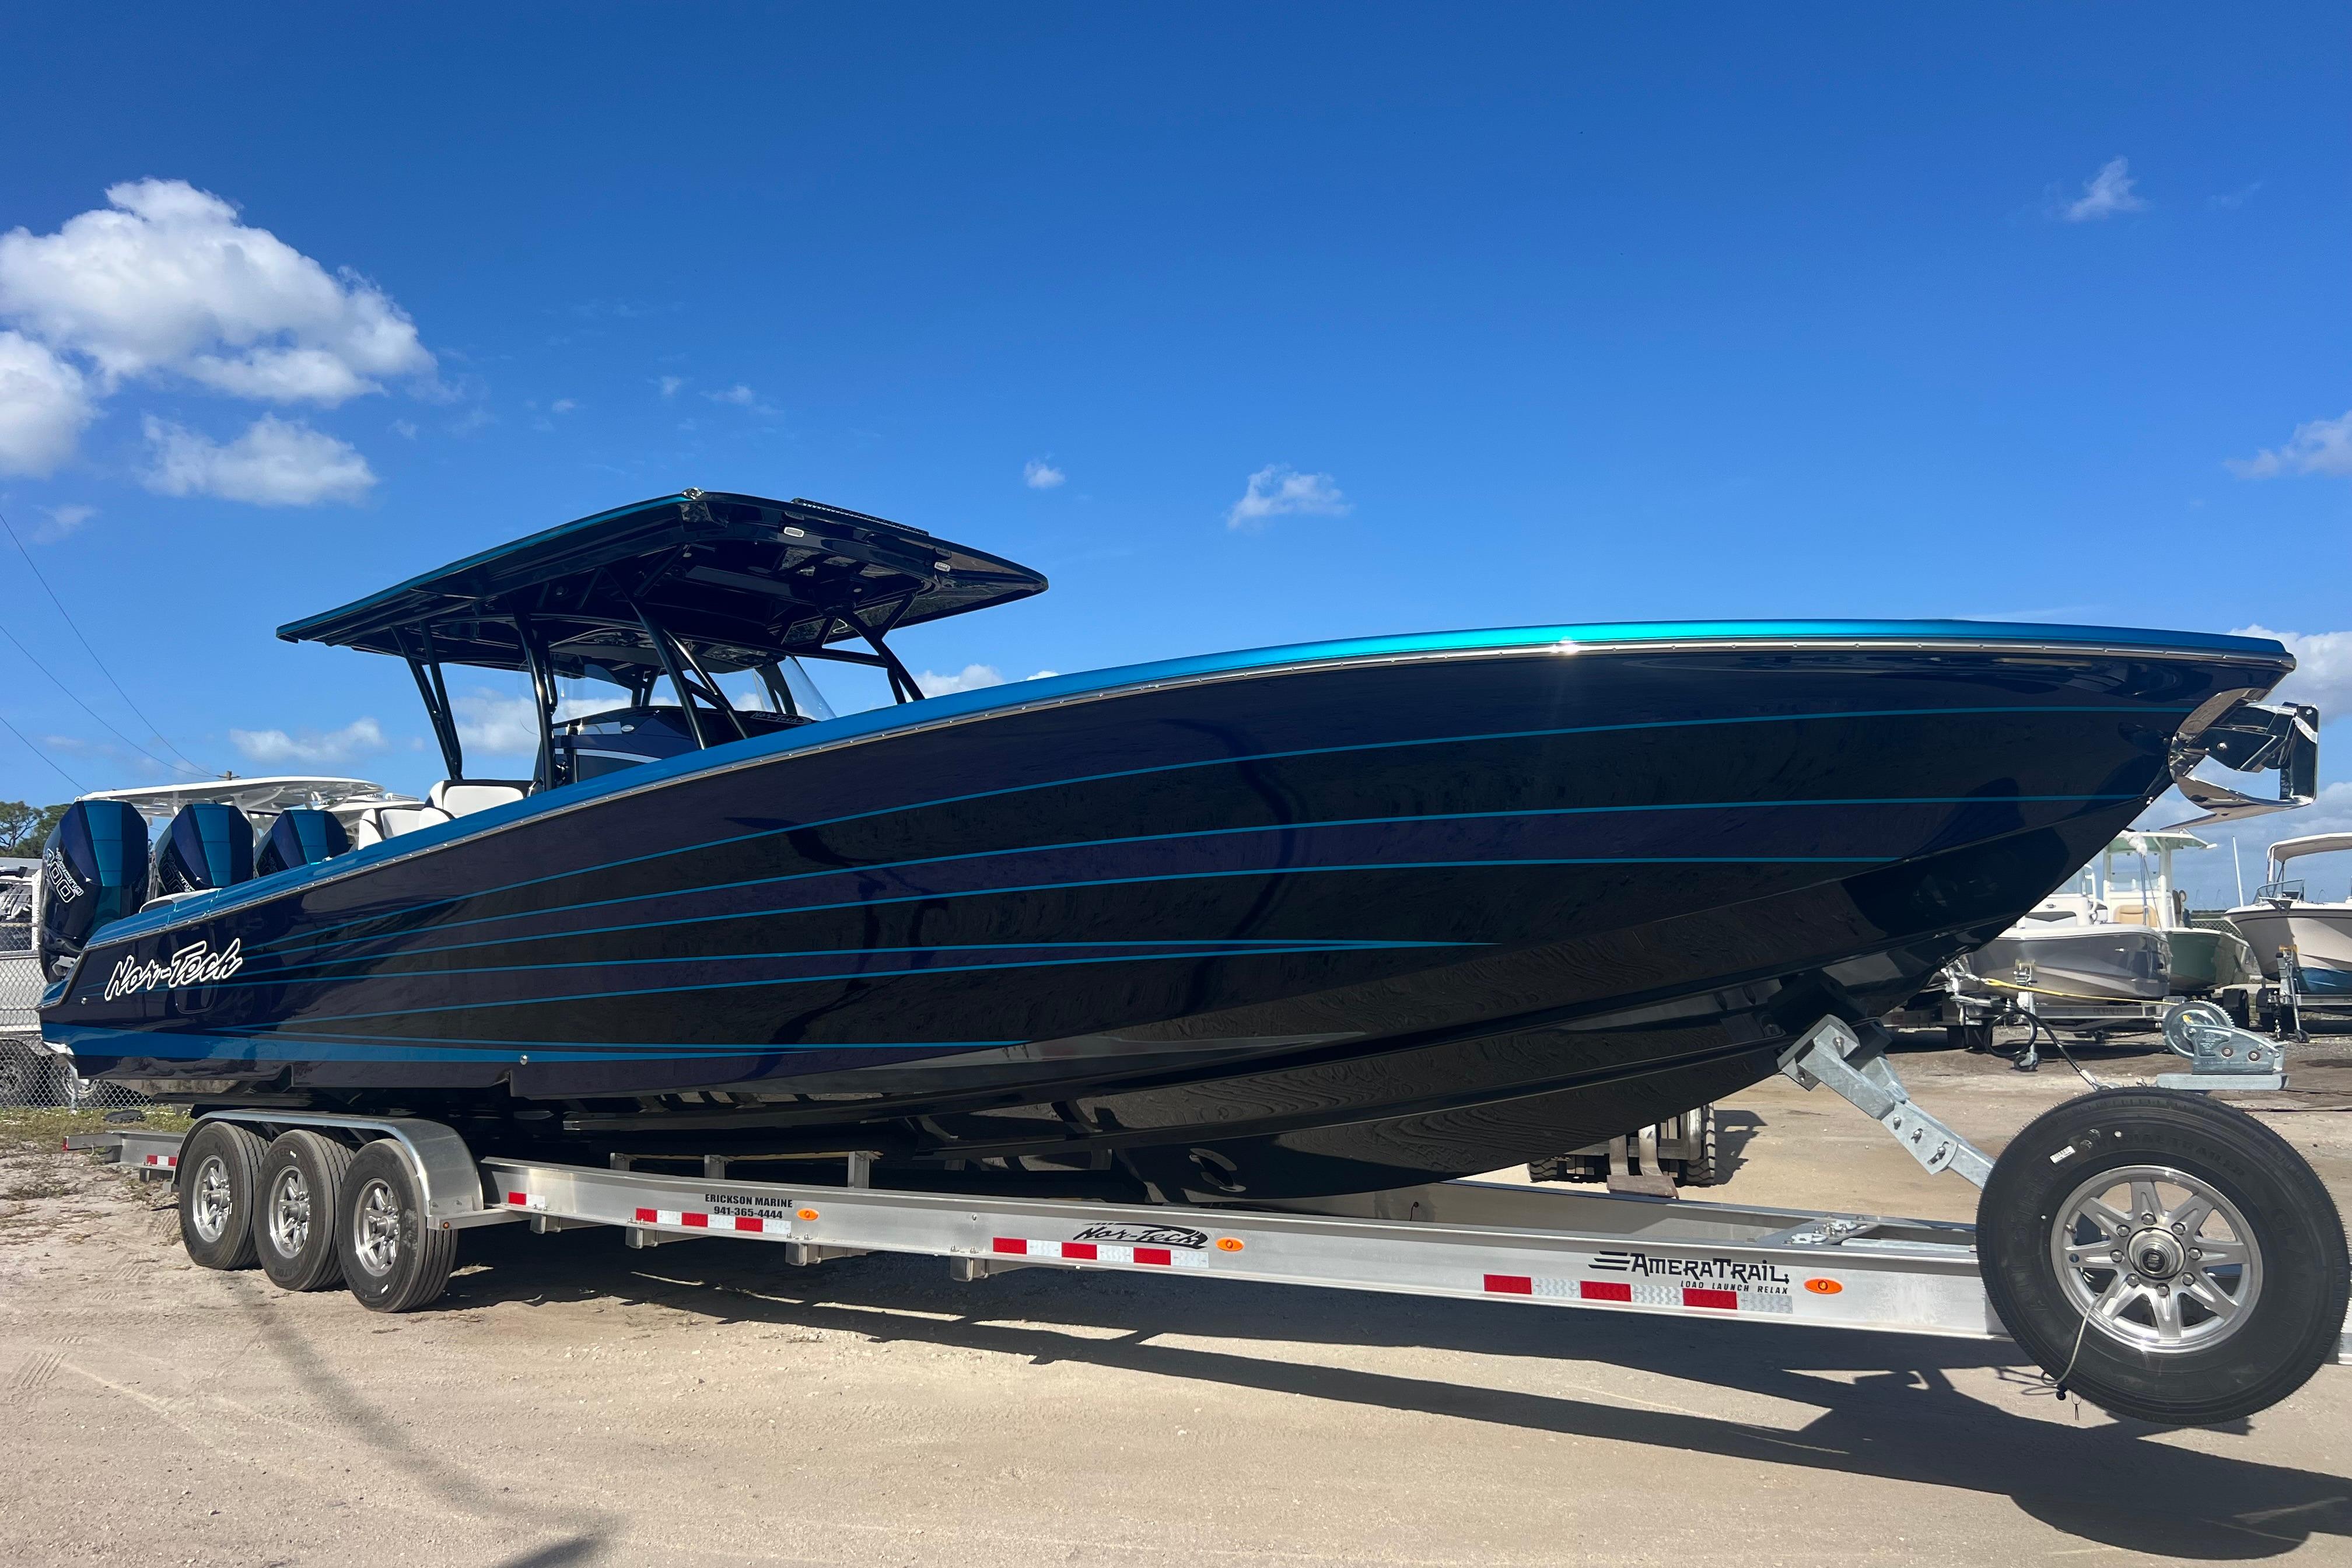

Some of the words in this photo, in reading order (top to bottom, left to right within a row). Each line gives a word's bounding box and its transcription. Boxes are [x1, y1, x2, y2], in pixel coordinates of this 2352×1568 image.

[104, 938, 243, 1002] Nor-Tech
[705, 1194, 752, 1205] ERICKSON
[755, 1197, 793, 1208] MARINE
[714, 1206, 782, 1219] 941-365-4444
[1681, 1280, 1703, 1289] LOAD
[1712, 1283, 1749, 1292] LAUNCH
[1757, 1286, 1788, 1294] RELAX
